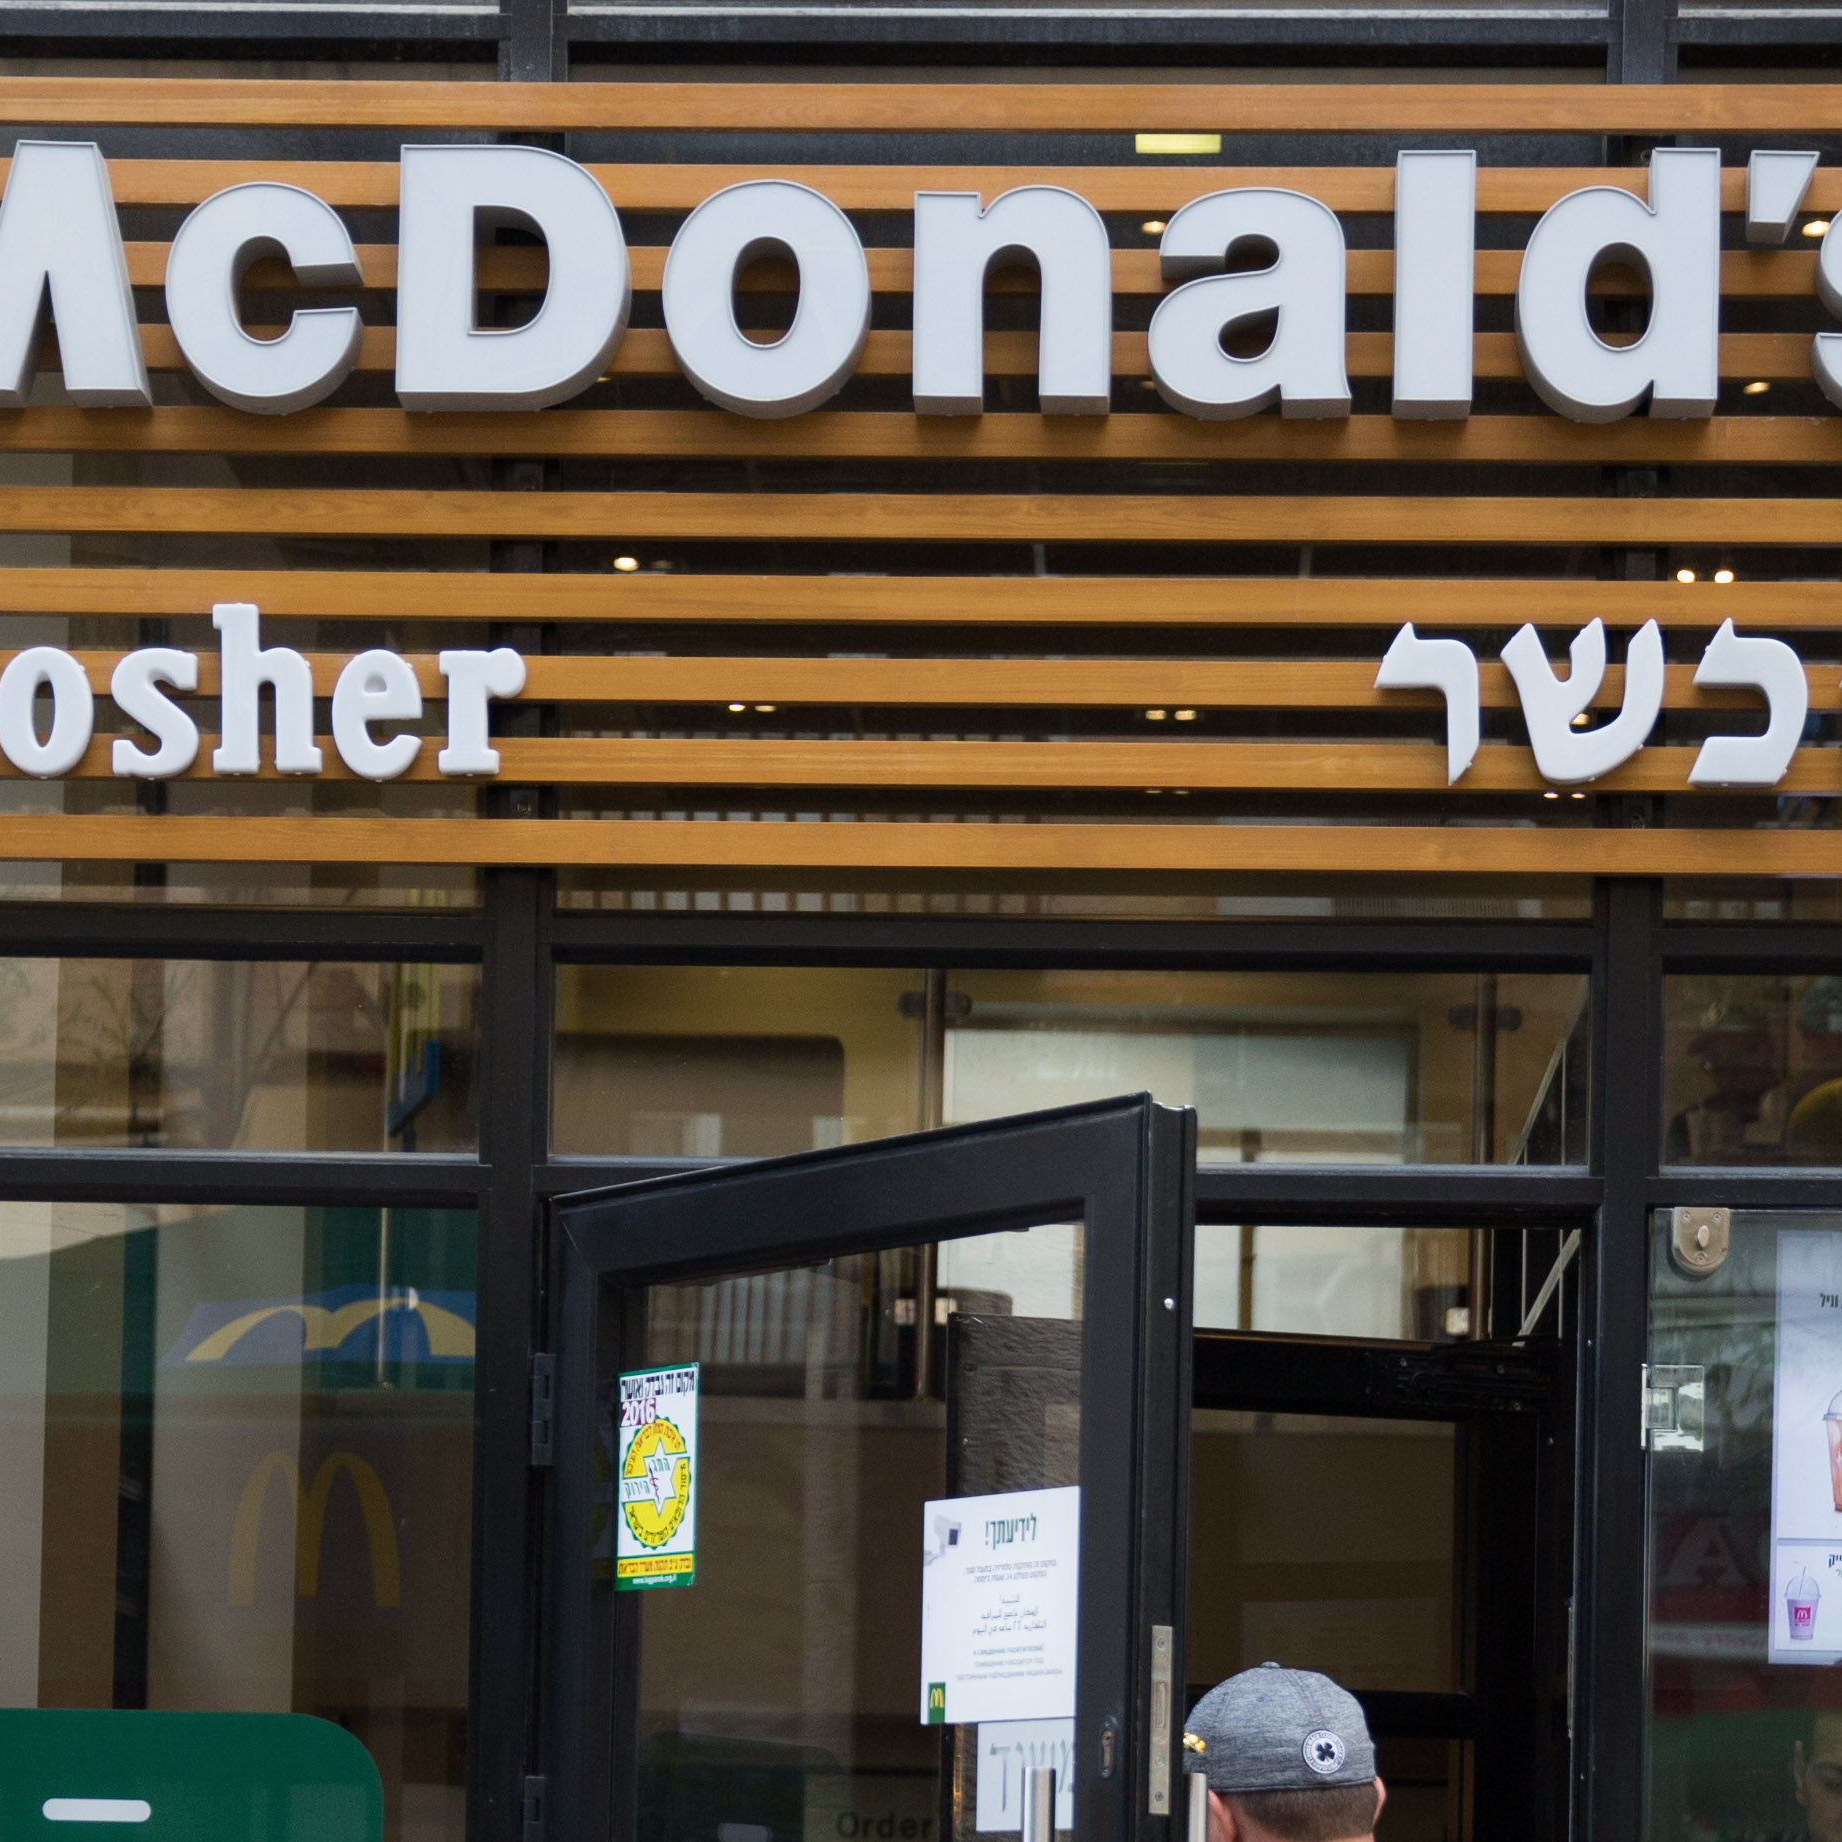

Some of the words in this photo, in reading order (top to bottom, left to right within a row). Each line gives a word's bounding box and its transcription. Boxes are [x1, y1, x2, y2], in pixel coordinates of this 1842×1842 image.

[621, 1398, 656, 1427] 2016
[984, 1512, 1037, 1551] לידיעתך!
[836, 1810, 934, 1839] Order
